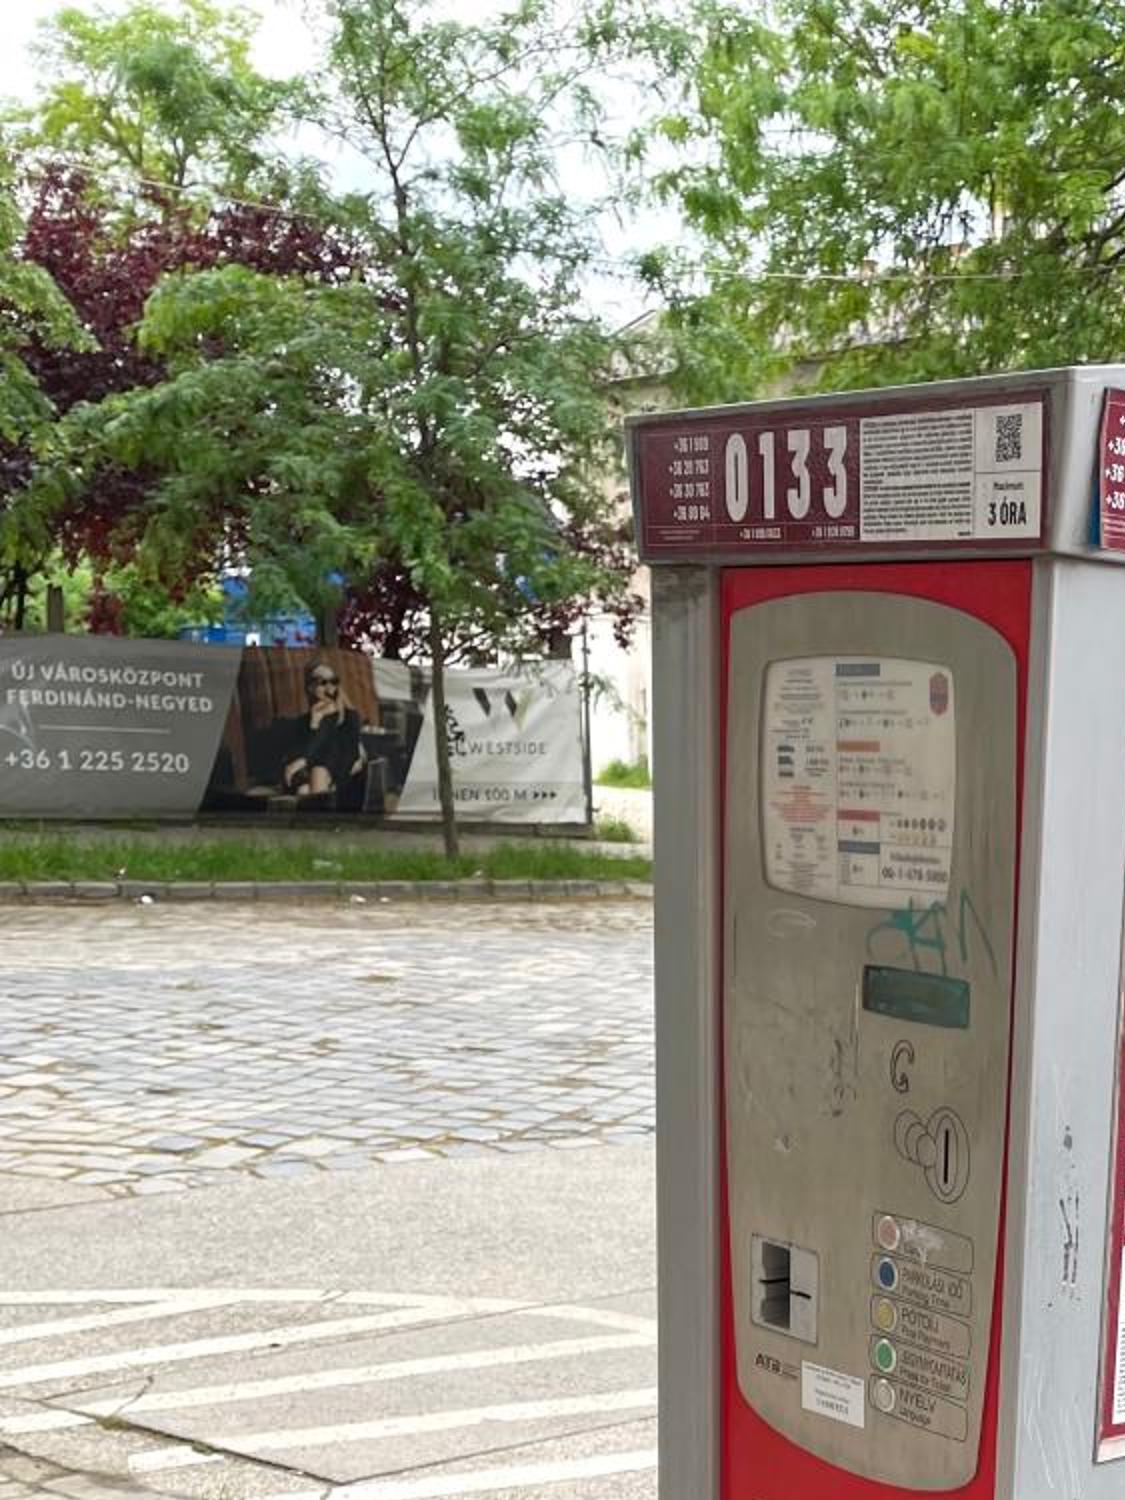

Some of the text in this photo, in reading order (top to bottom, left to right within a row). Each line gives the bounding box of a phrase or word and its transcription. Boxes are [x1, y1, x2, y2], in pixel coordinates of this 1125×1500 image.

[725, 426, 847, 522] 0133
[988, 496, 1027, 526] 3 ÓRA
[12, 660, 204, 687] ÚJ VÁROSKÖZPONT
[6, 688, 213, 712] FERDINÁND-NEGYED
[469, 741, 547, 755] WESTSIDE
[5, 750, 190, 773] +36 1 225 2520
